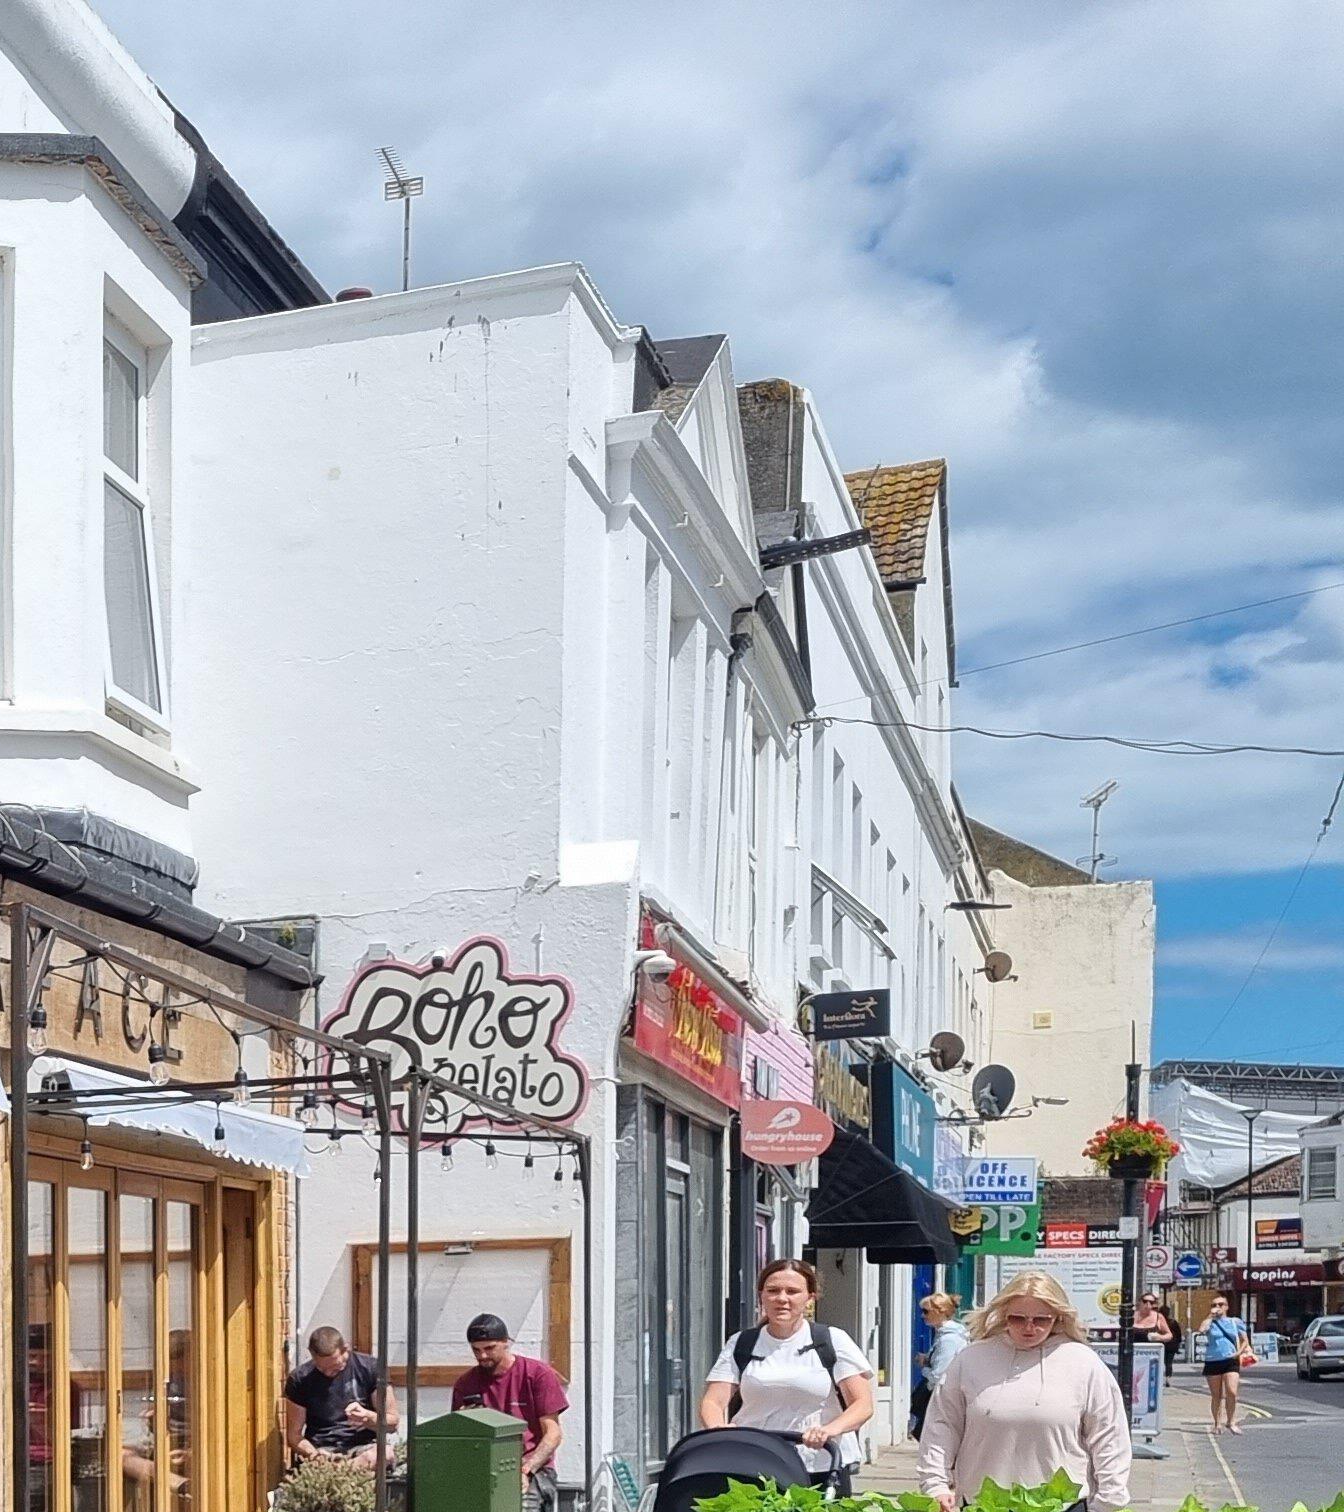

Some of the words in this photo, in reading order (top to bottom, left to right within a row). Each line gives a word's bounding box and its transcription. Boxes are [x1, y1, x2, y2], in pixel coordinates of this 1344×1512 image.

[342, 961, 551, 1089] Boho
[744, 1130, 824, 1143] hungryhouse
[980, 1163, 1008, 1174] OFF
[1048, 1230, 1085, 1240] SPECS
[1088, 1230, 1121, 1240] DIREC
